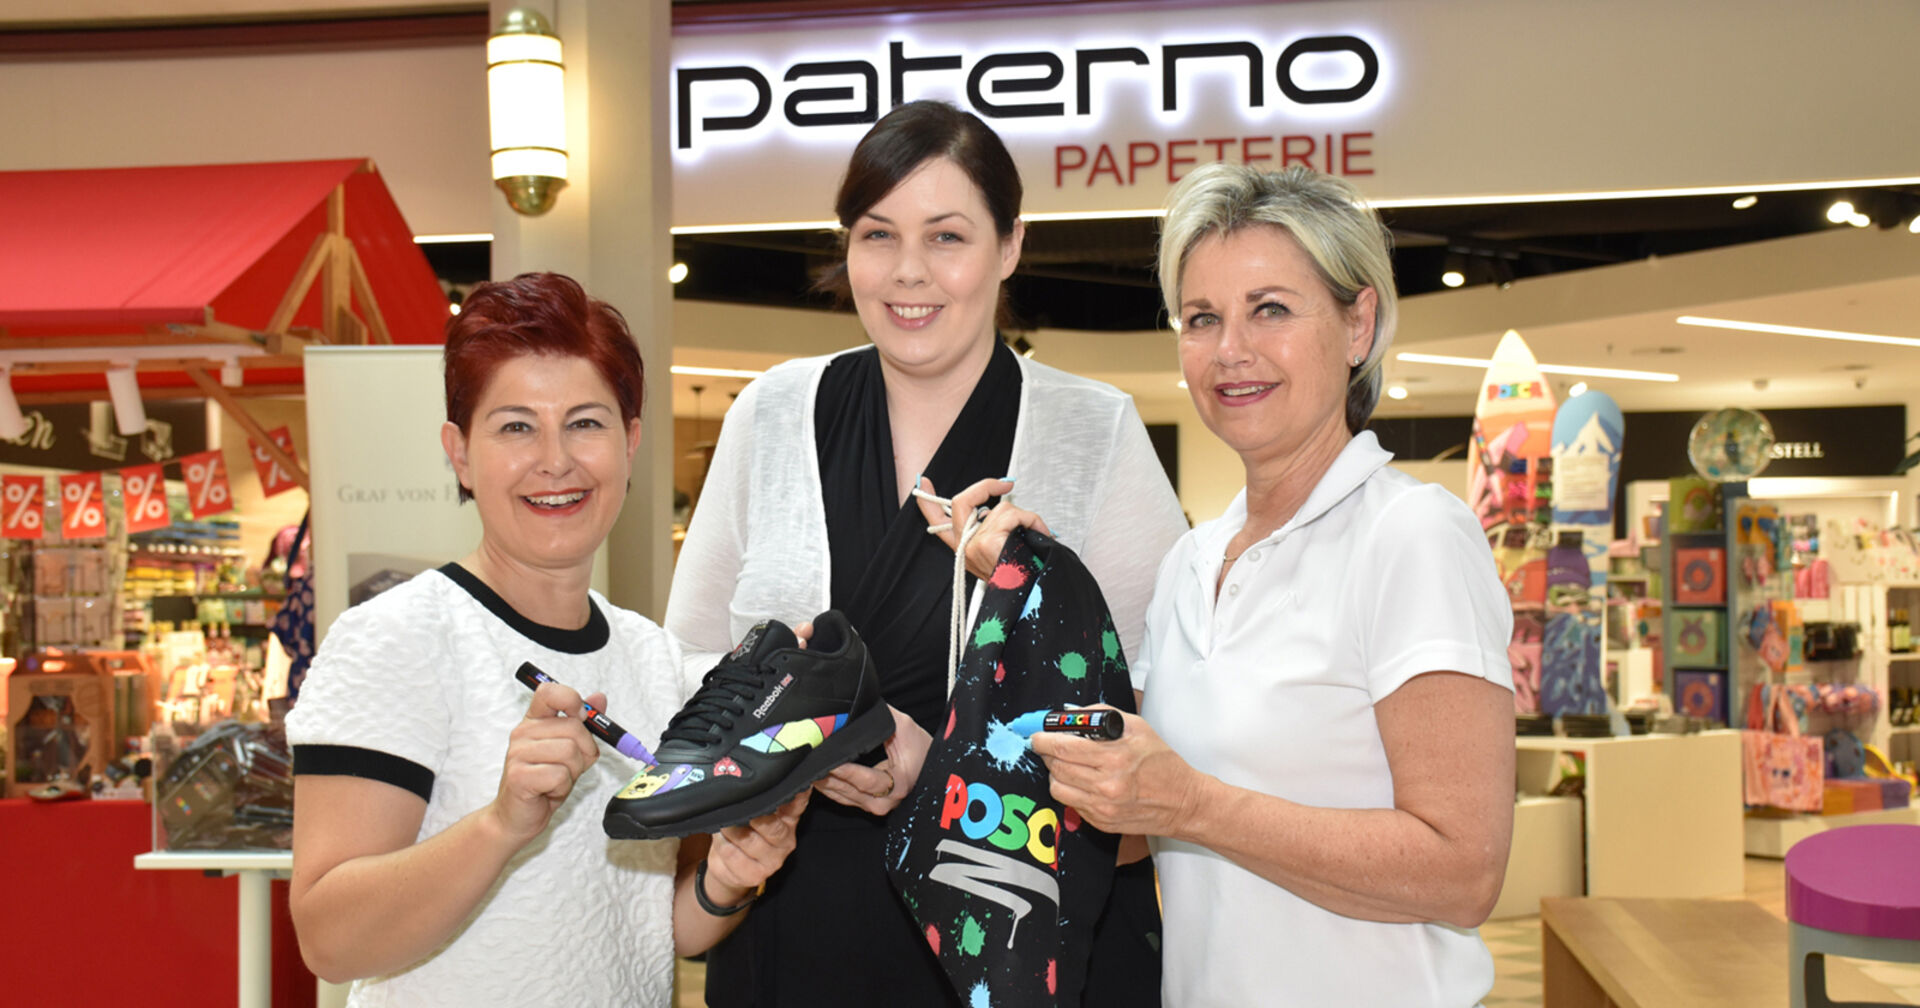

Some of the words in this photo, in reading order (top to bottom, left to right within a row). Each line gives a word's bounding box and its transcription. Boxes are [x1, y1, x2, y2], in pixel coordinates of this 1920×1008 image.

[677, 35, 1379, 149] paterno
[1055, 132, 1374, 188] PAPETERIE
[752, 685, 785, 719] Reebok
[1060, 714, 1090, 726] POSCA
